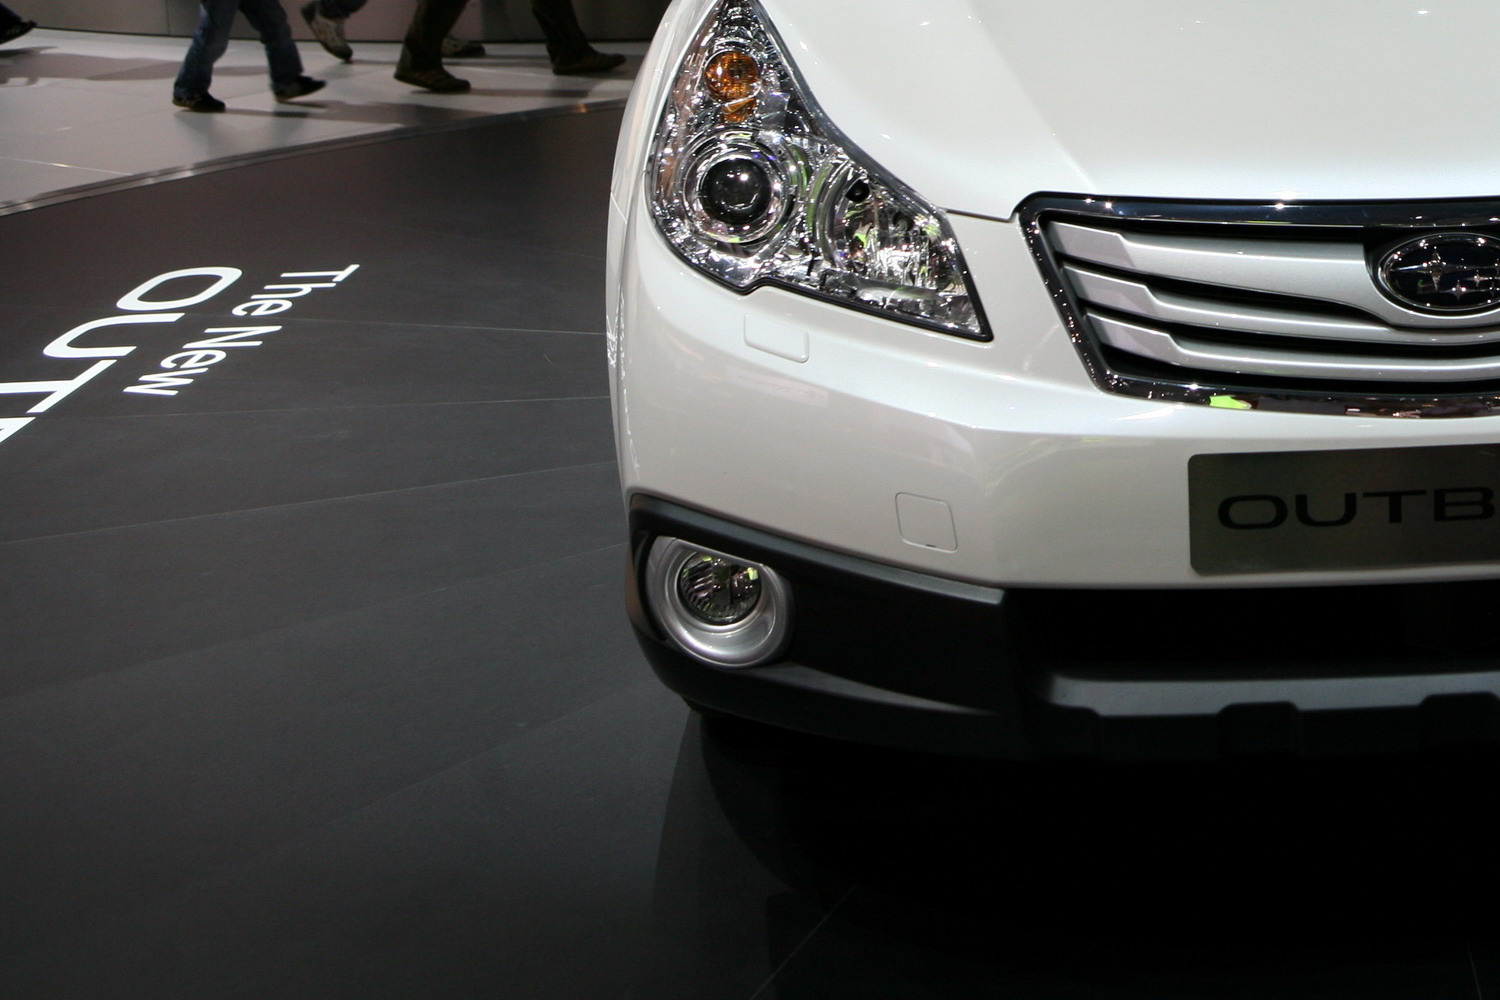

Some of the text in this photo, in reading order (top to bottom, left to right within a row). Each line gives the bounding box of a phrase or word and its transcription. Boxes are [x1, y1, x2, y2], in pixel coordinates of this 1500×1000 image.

[0, 266, 242, 444] OUT
[123, 264, 360, 396] The New
